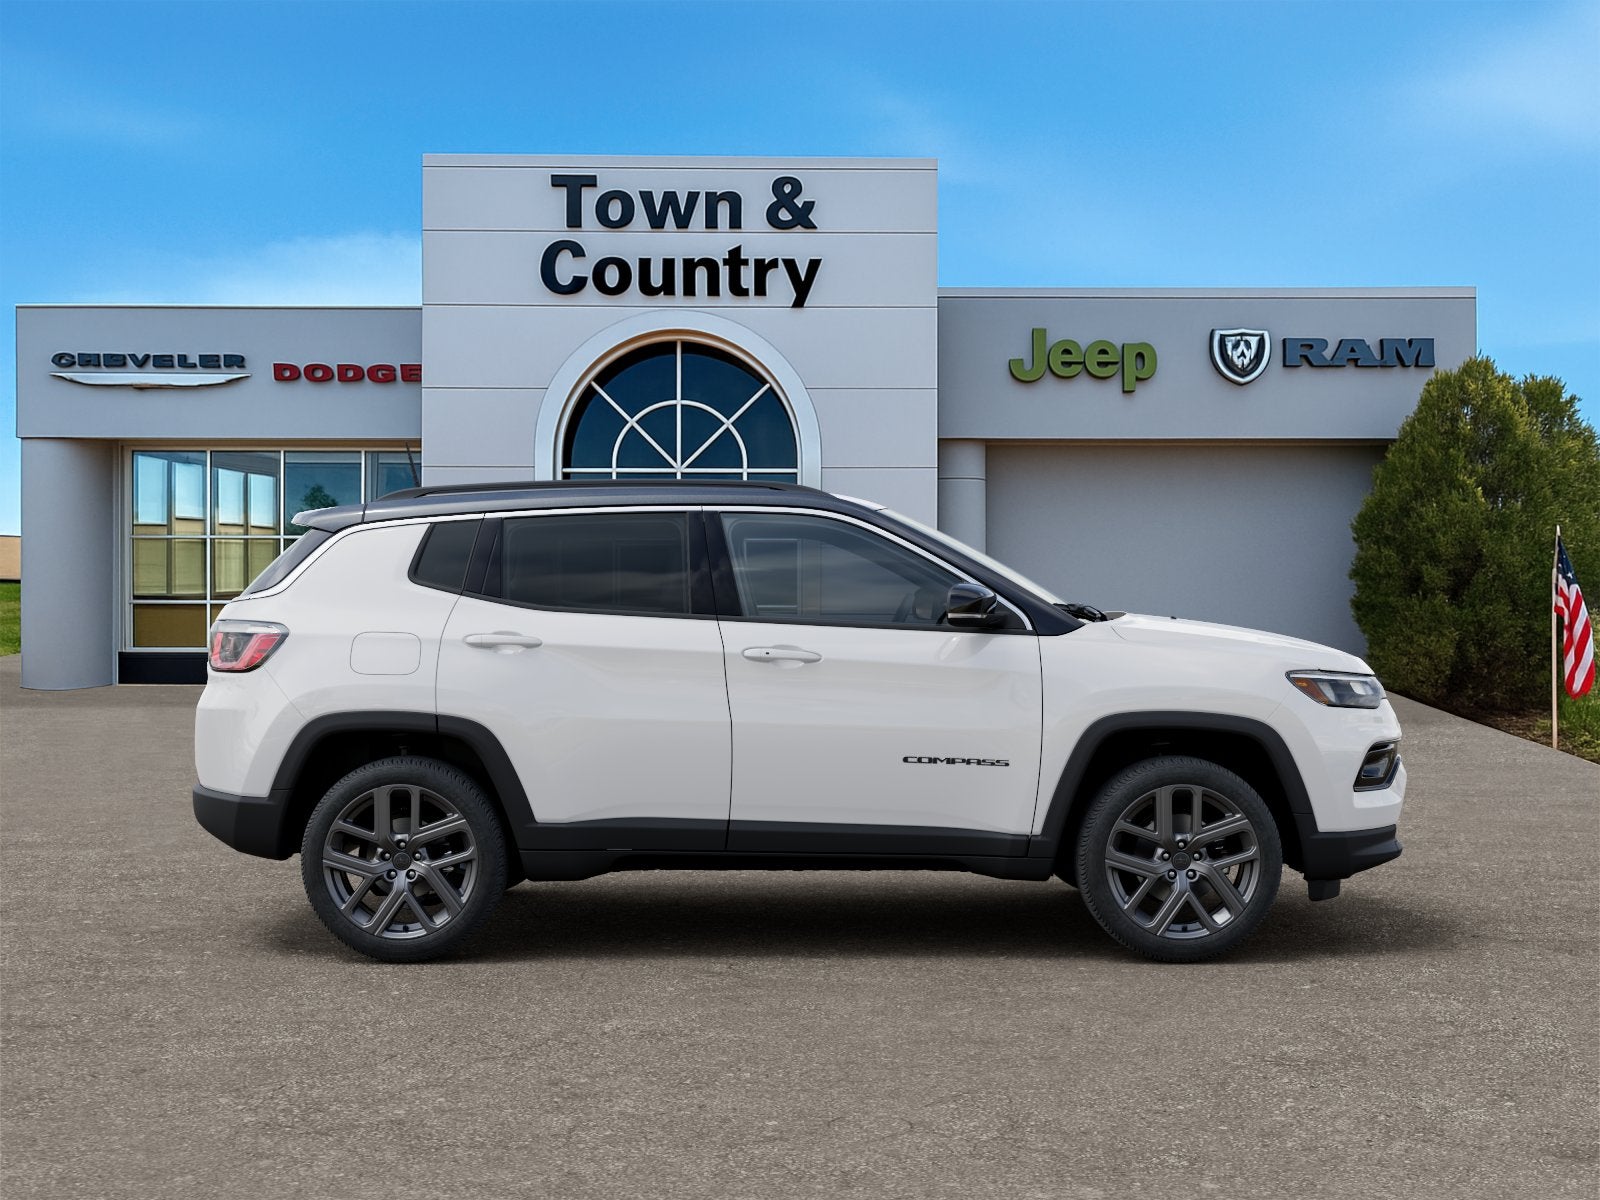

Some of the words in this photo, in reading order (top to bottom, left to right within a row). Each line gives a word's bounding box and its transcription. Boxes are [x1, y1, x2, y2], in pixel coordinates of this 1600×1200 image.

[551, 174, 742, 229] Town
[766, 176, 818, 229] &
[540, 240, 822, 308] Country
[273, 363, 422, 383] DODGE
[1009, 328, 1157, 393] Jeep
[1283, 338, 1435, 368] RAM
[902, 756, 1010, 767] COMPASS
